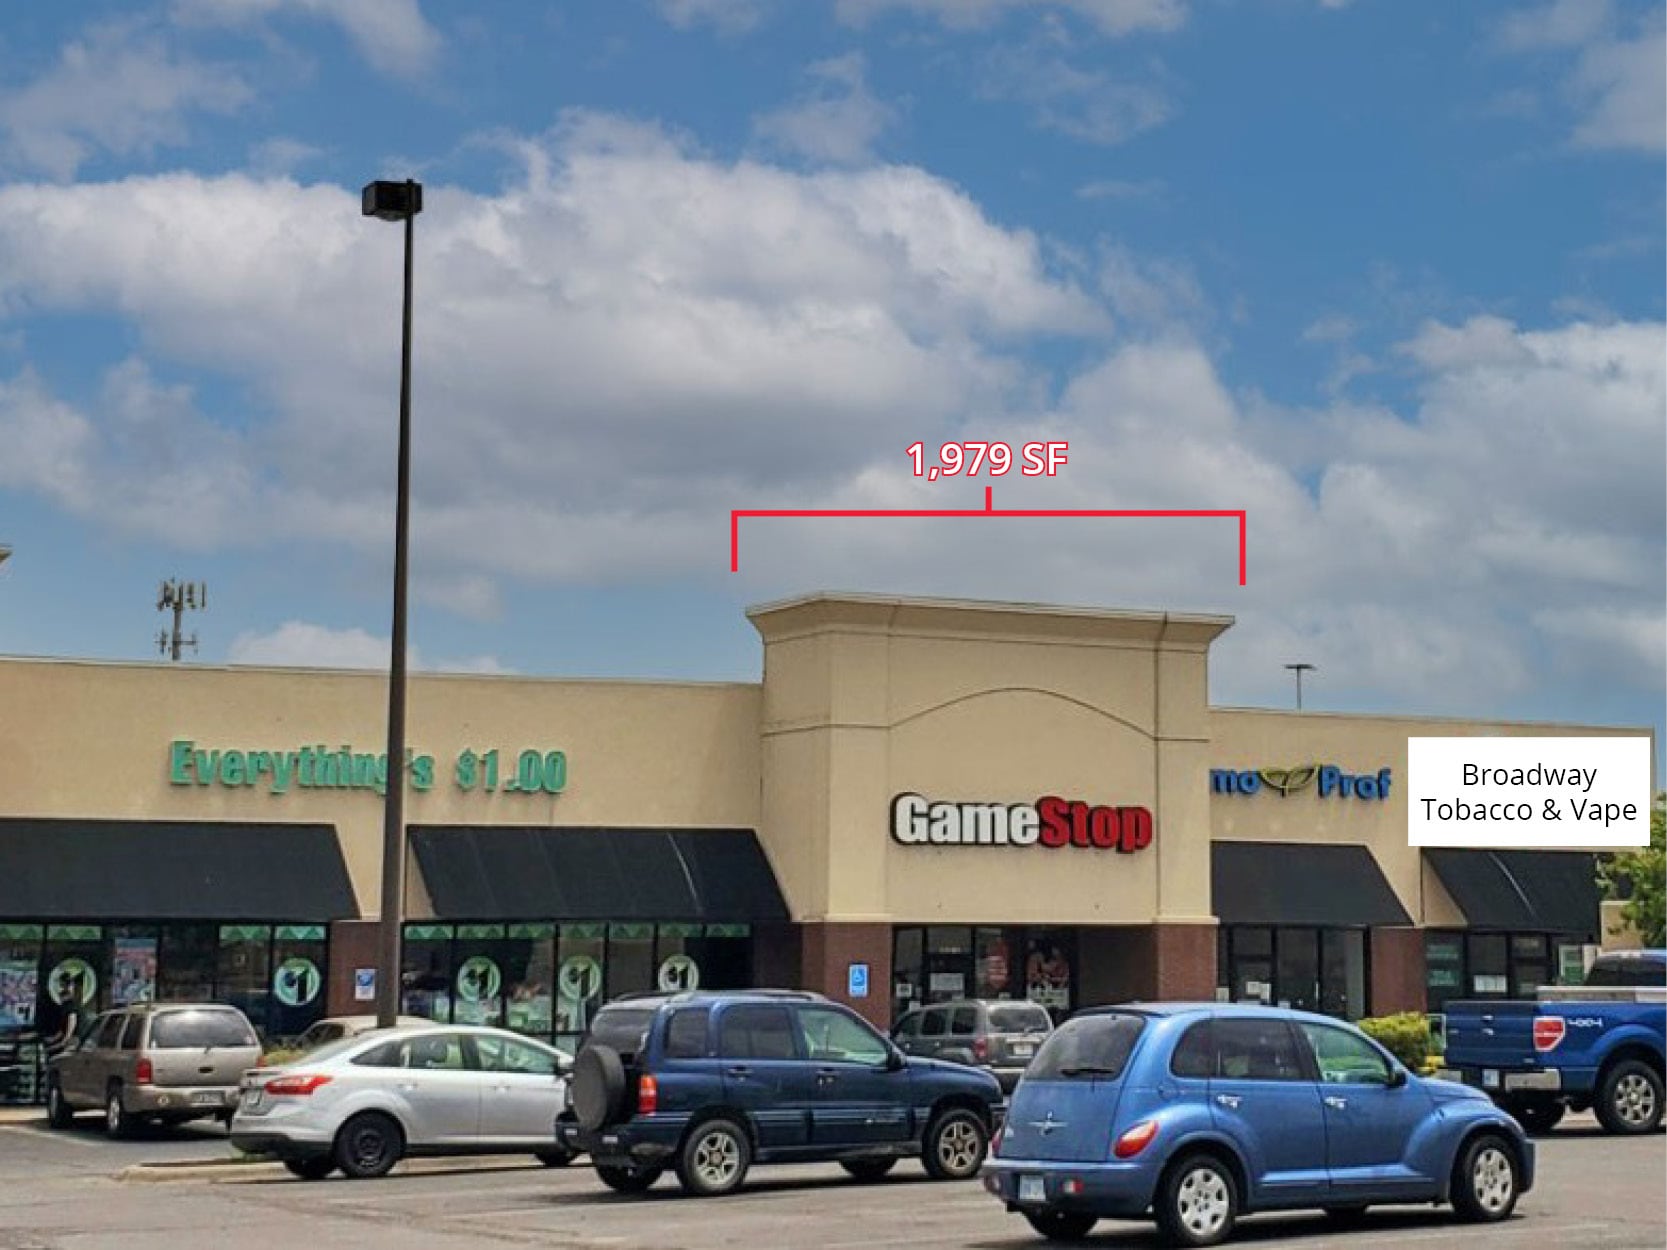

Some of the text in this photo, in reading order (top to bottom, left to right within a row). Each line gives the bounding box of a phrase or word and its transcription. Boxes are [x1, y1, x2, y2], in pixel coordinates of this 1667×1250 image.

[455, 748, 567, 793] $1.00
[1317, 763, 1392, 800] Prof
[889, 791, 1153, 854] GameStop
